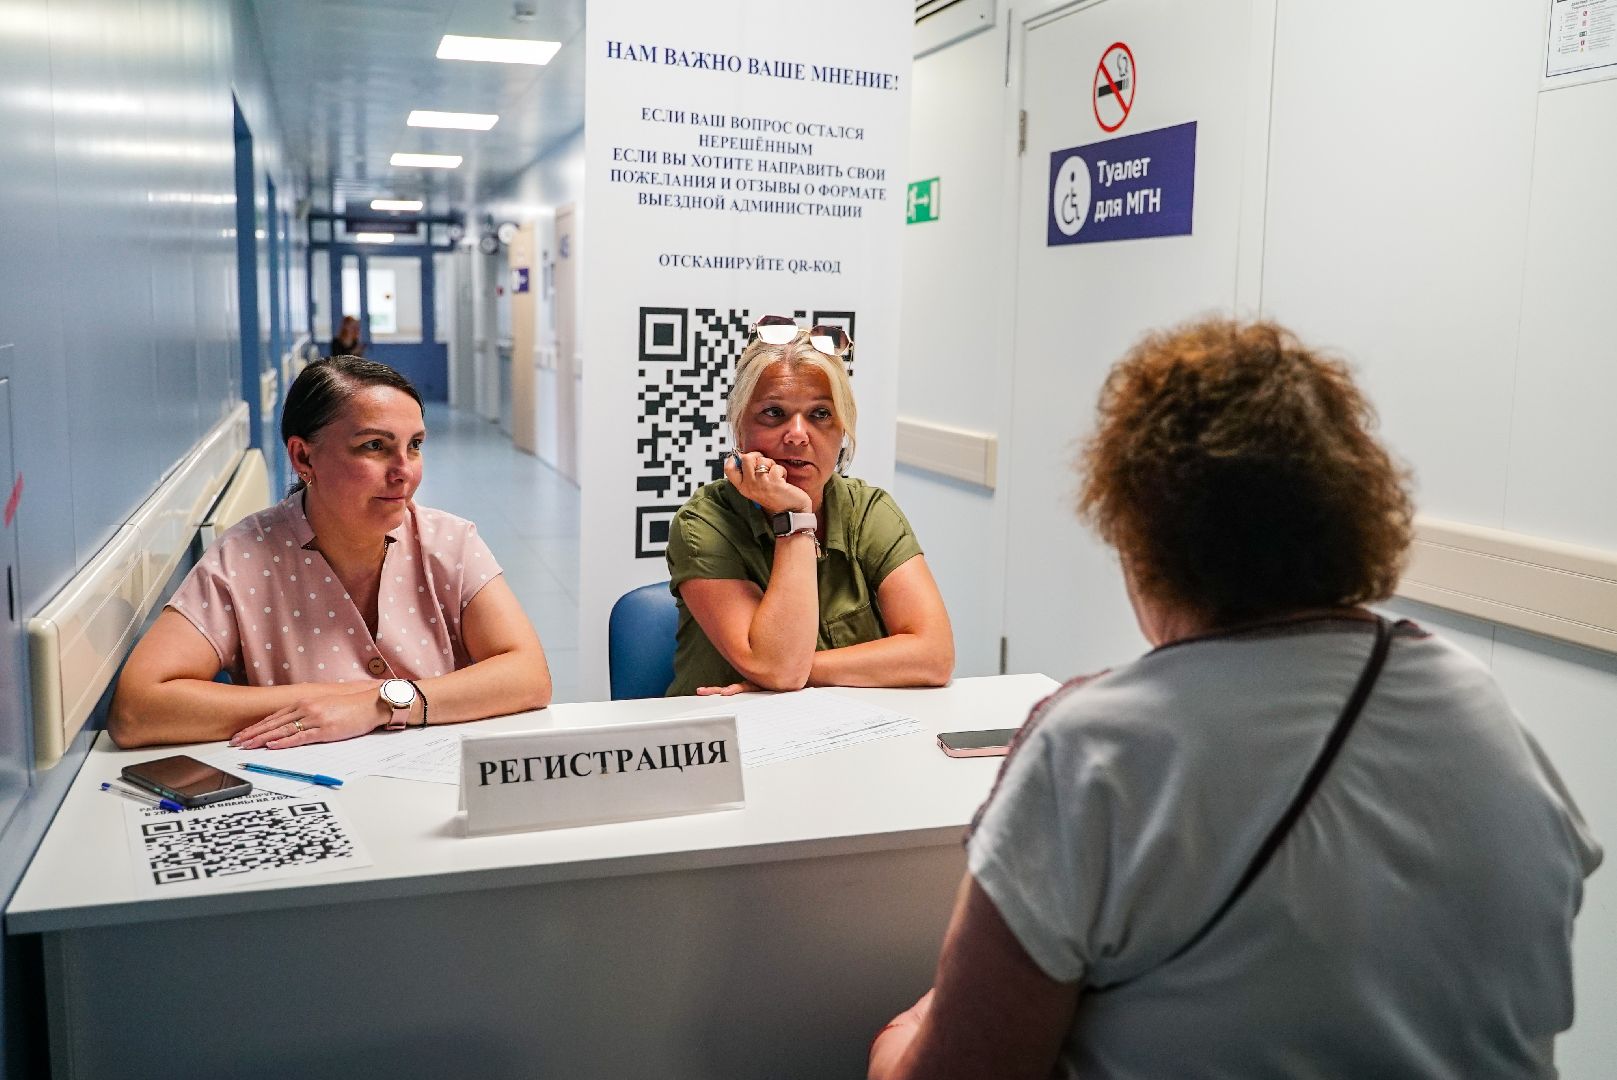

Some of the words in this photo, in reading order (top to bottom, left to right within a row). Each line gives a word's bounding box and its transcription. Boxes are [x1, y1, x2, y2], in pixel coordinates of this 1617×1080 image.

[607, 41, 657, 63] НАМ
[664, 48, 742, 72] ВАЖНО
[748, 57, 805, 80] ВАШЕ
[811, 65, 898, 90] МНЕНИЕ!
[642, 108, 685, 124] ЕСЛИ
[690, 112, 725, 128] ВАШ
[731, 116, 792, 134] ВОПРОС
[796, 122, 864, 140] ОСТАЛСЯ
[700, 134, 812, 156] НЕРЕШЁННЫМ
[614, 148, 656, 164] ЕСЛИ
[663, 152, 686, 166] ВЫ
[691, 154, 752, 171] ХОТИТЕ
[758, 160, 843, 177] НАПРАВИТЬ
[847, 167, 884, 181] СВОИ
[1097, 157, 1151, 187] Туалет
[611, 169, 716, 189] ПОЖЕЛАНИЯ
[721, 178, 731, 190] И
[736, 178, 800, 194] ОТЗЫВЫ
[804, 184, 814, 195] О
[818, 184, 886, 200] ФОРМАТЕ
[638, 192, 724, 210] ВЫЕЗДНОЙ
[730, 199, 862, 218] АДМИНИСТРАЦИИ
[1094, 198, 1122, 223] для
[1126, 188, 1161, 215] МГН
[659, 254, 784, 271] ОТСКАНИРУЙТЕ
[788, 260, 840, 274] QR-КОД
[478, 740, 729, 787] РЕГИСТРАЦИЯ
